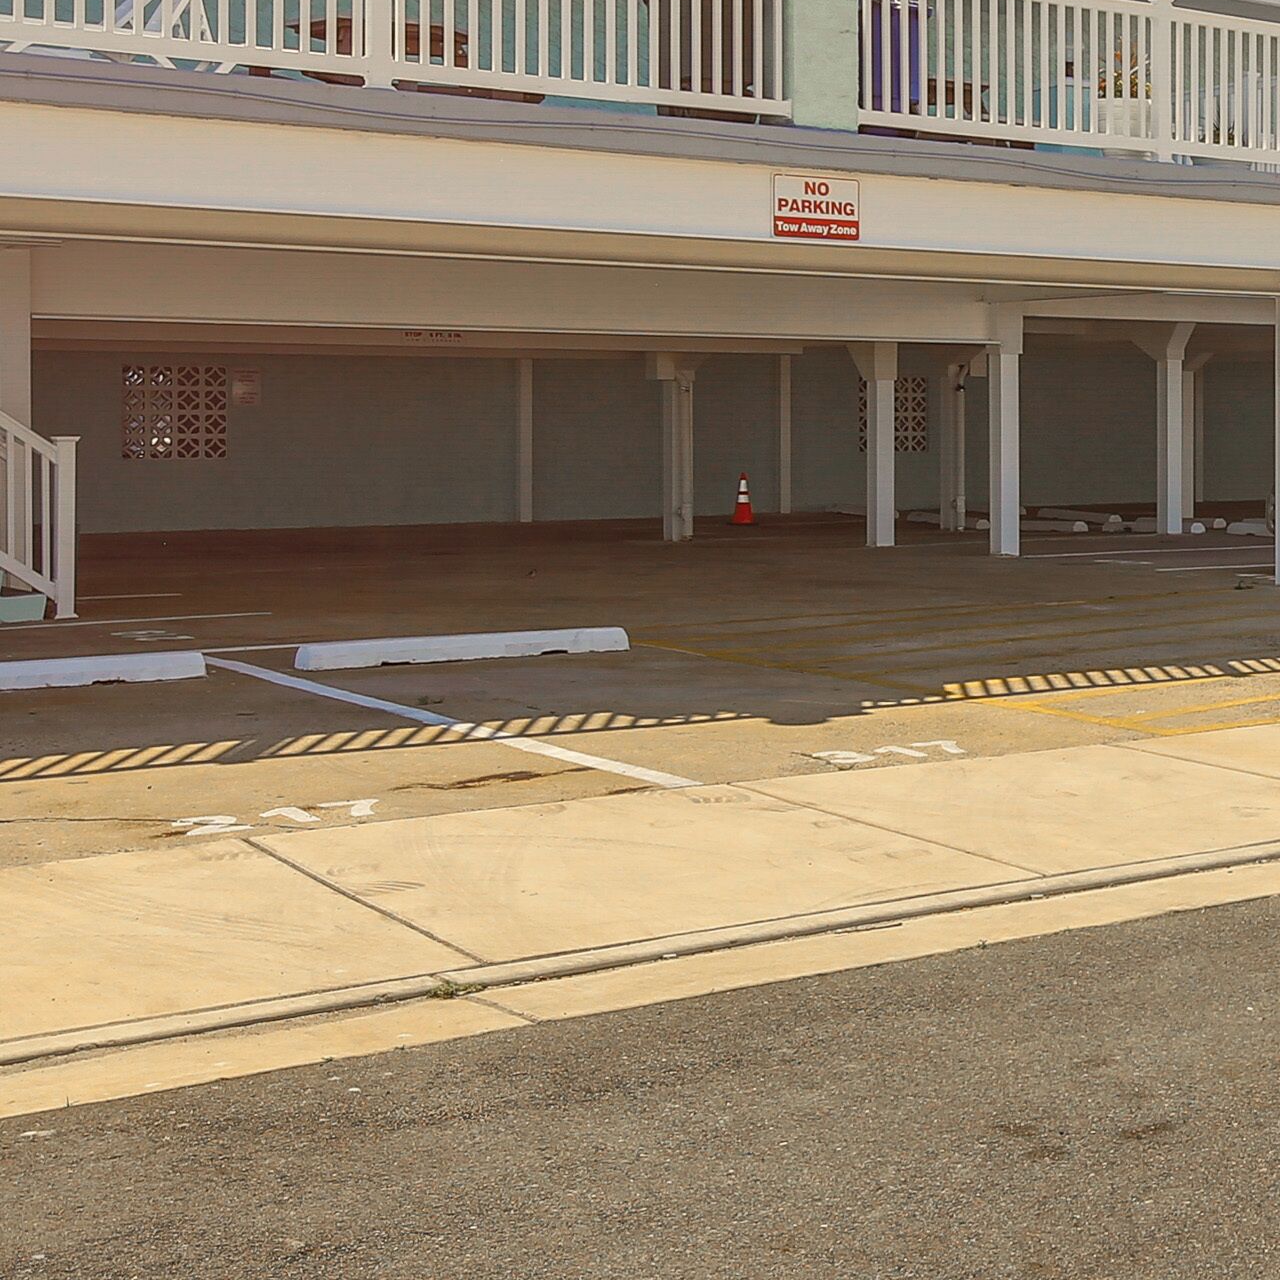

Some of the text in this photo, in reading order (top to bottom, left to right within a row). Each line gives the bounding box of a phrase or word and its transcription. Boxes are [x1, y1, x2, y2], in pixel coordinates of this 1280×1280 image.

[804, 181, 830, 196] NO
[777, 198, 855, 216] PARKING
[776, 221, 857, 235] Tow Away Zone
